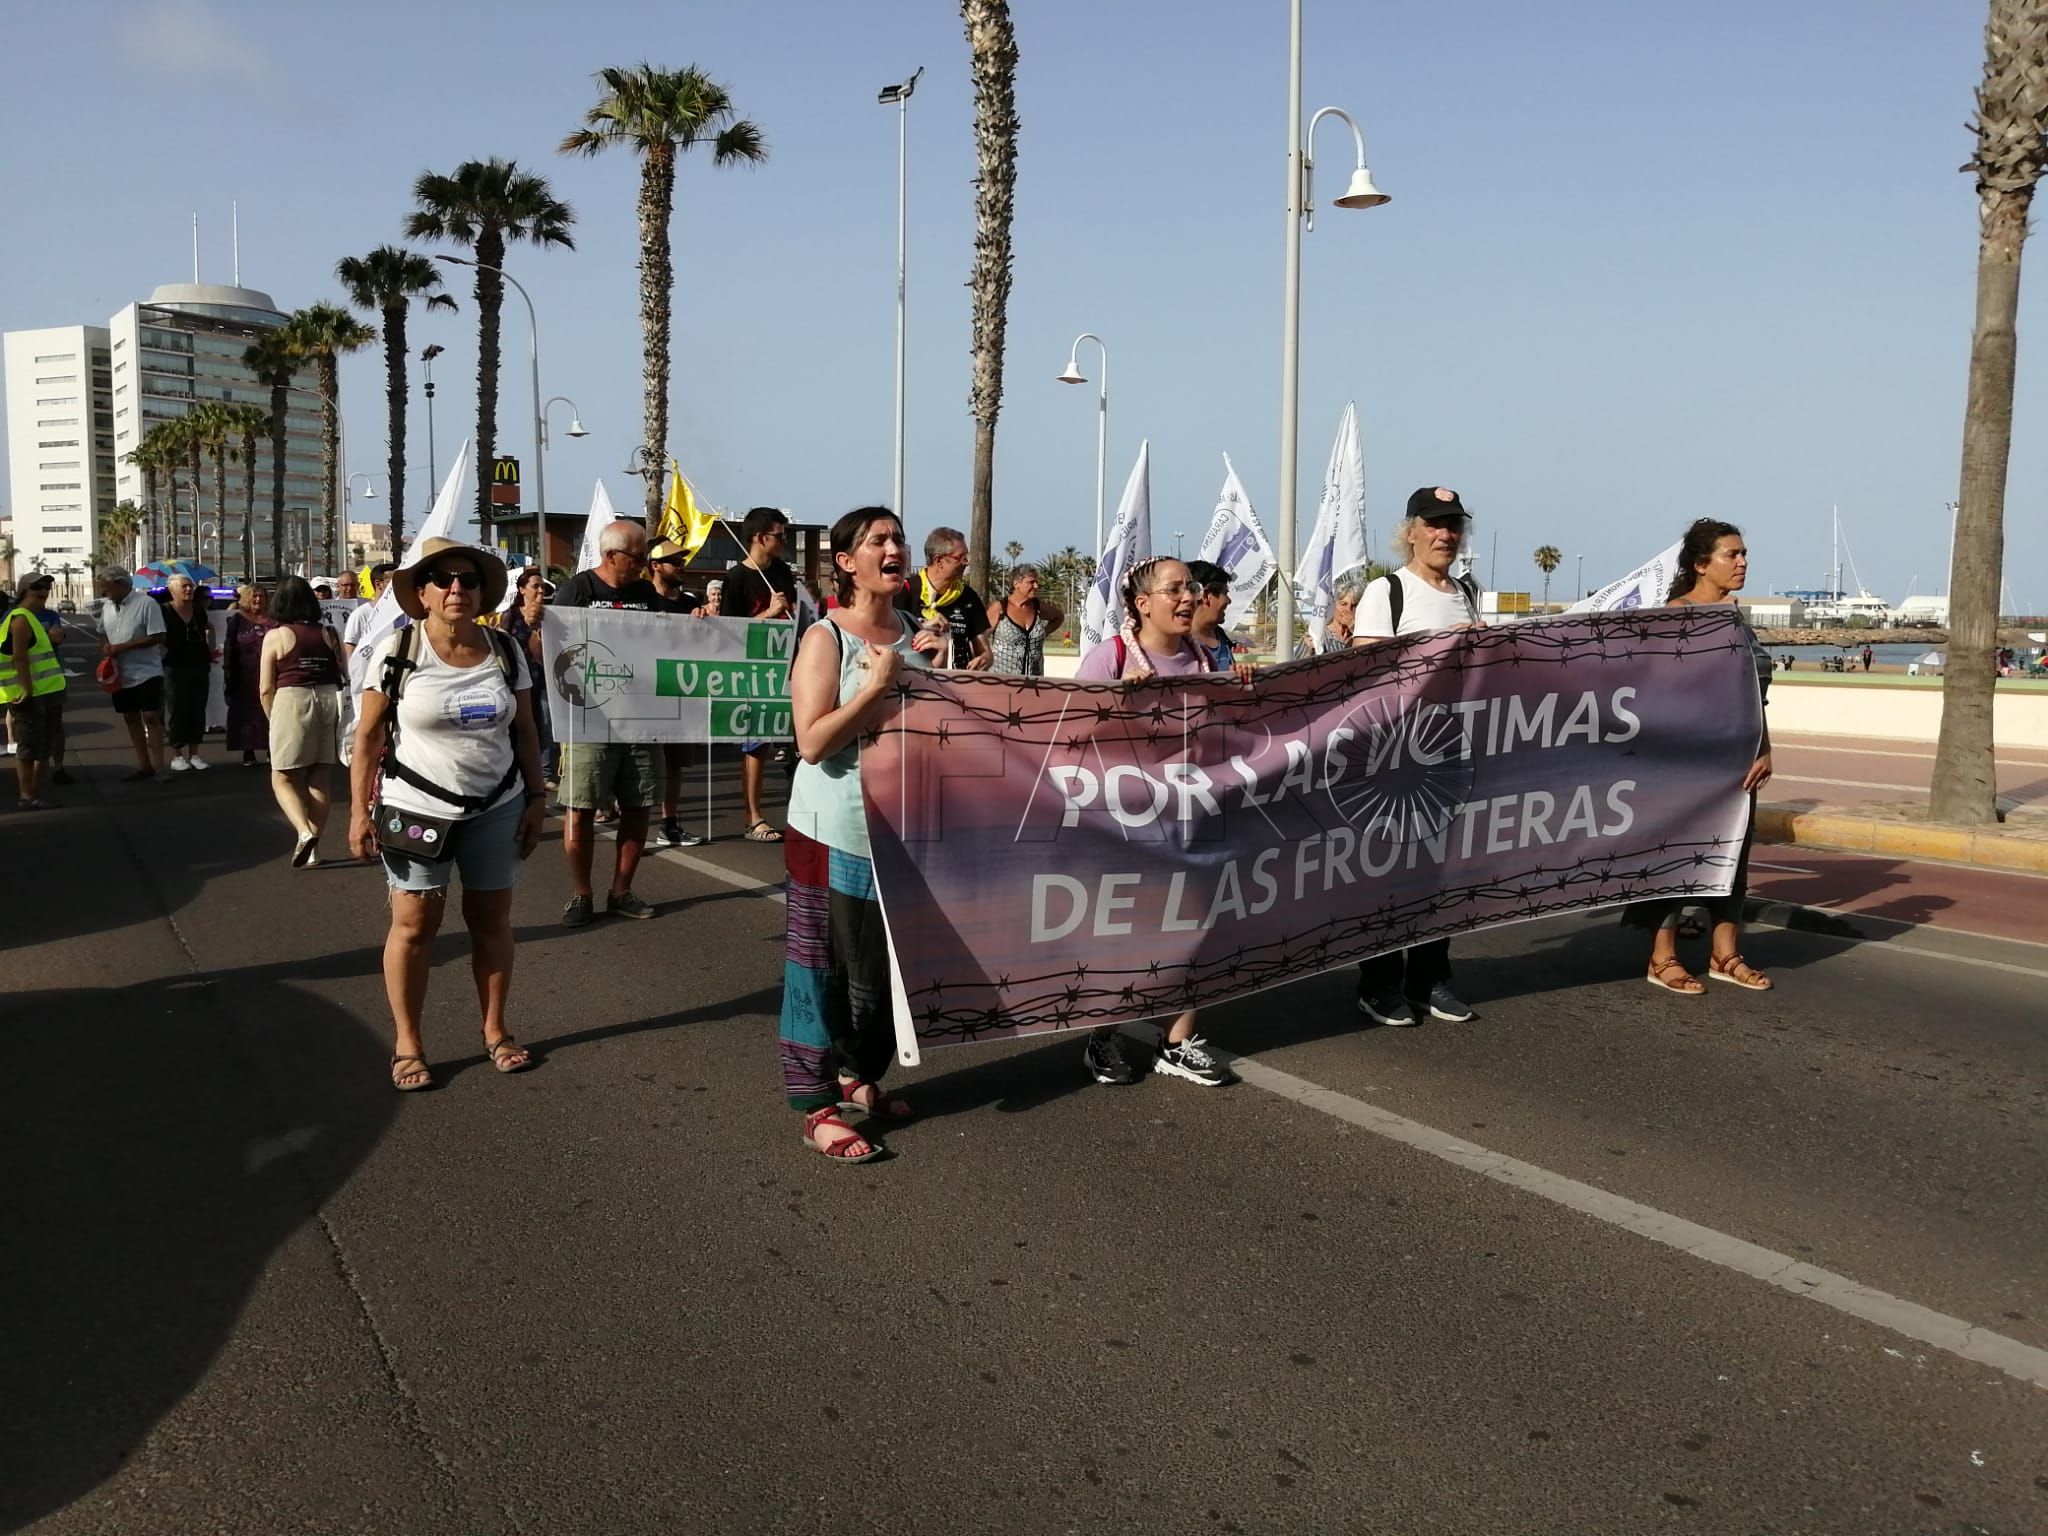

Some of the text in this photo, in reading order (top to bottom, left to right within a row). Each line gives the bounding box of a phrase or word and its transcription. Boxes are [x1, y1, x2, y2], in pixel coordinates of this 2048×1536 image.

[1048, 764, 1223, 828] POR
[1231, 727, 1356, 808] LAS
[1030, 780, 1637, 943] DE LAS FRONTERAS
